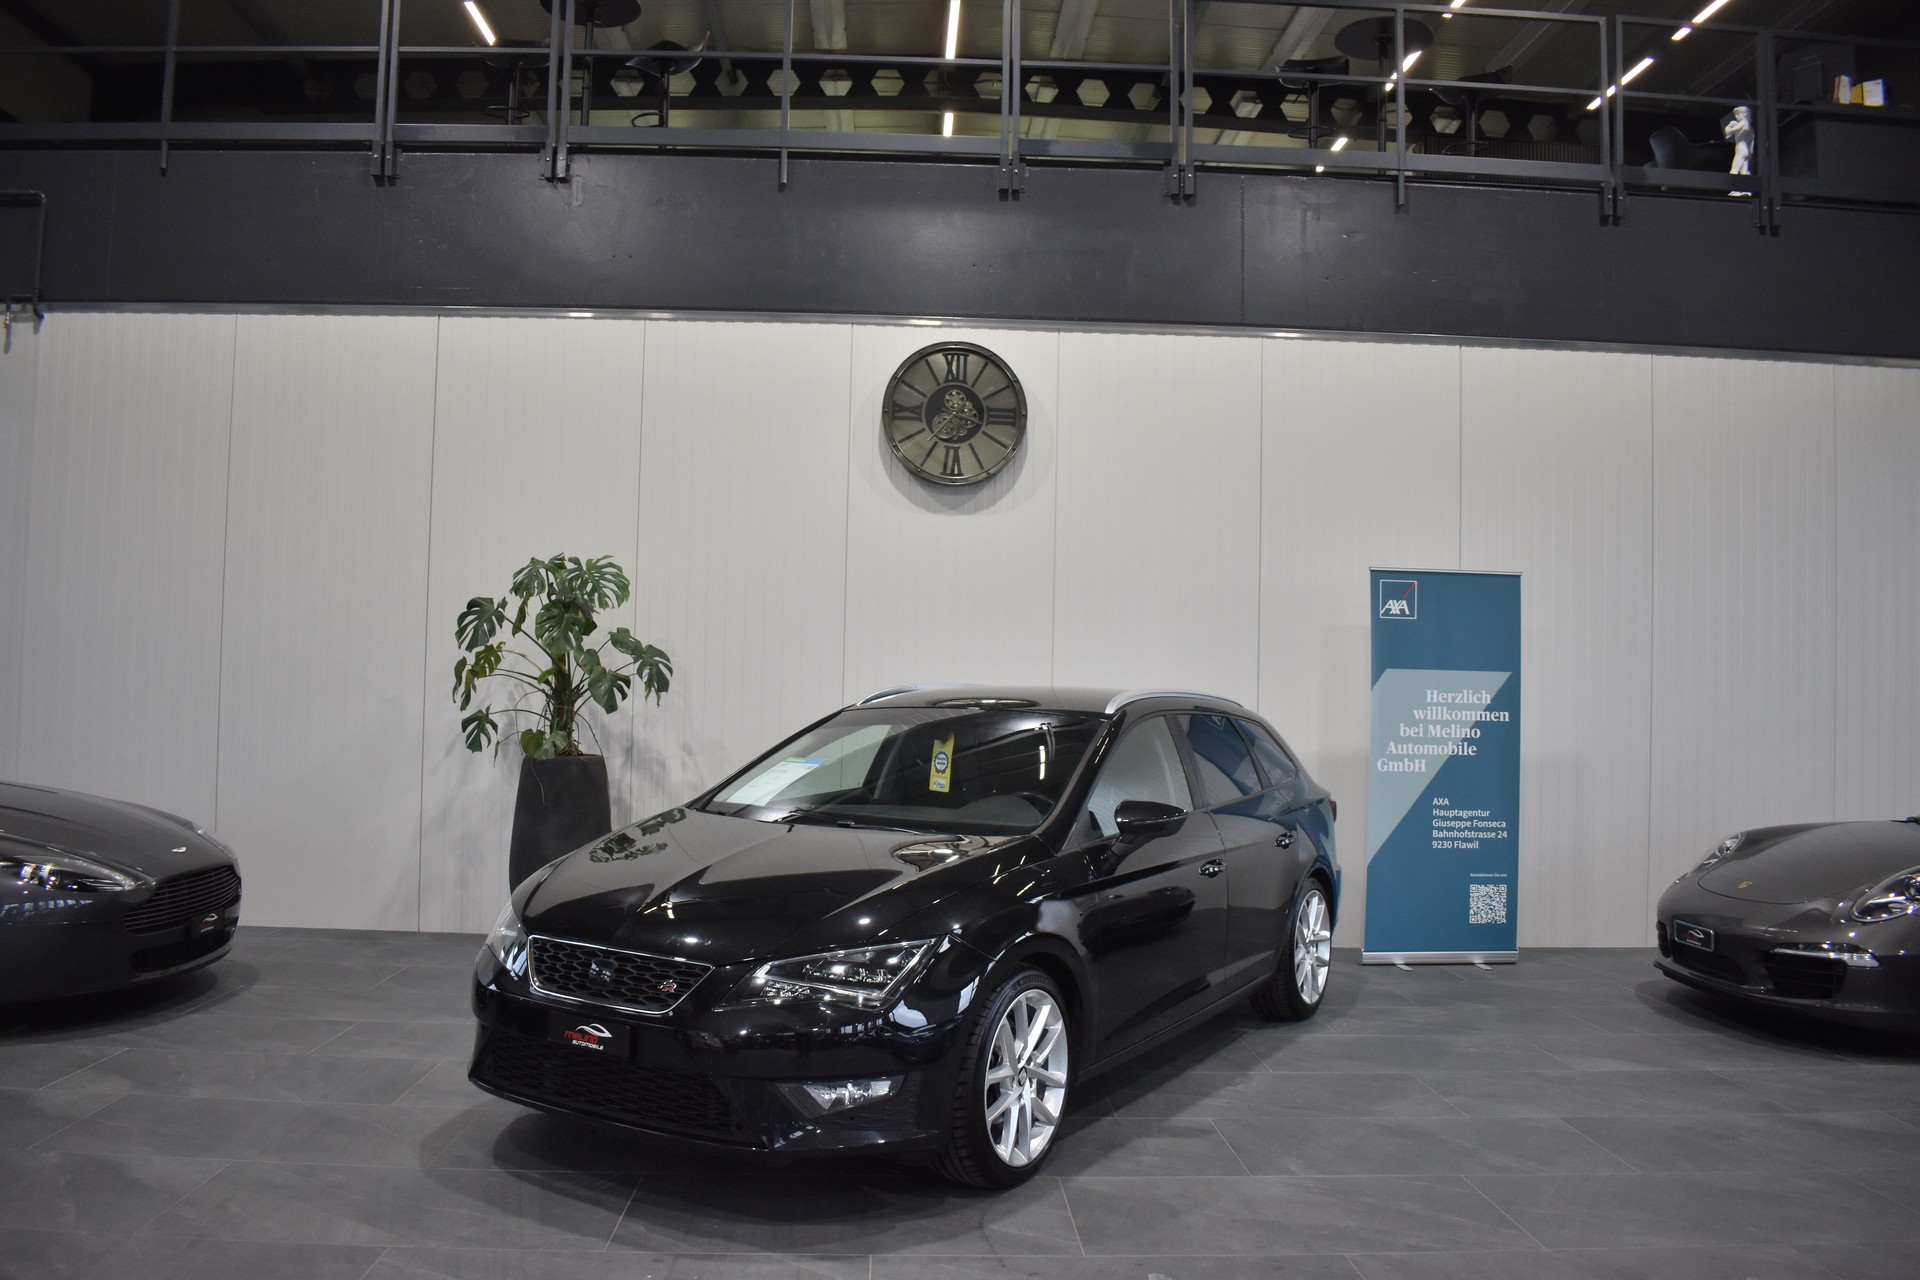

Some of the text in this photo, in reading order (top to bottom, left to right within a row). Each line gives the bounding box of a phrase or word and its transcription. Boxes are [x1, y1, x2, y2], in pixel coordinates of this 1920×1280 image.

[942, 352, 969, 384] XII
[986, 405, 1017, 427] III
[1381, 599, 1410, 615] AXA
[1426, 689, 1491, 704] Herzlich
[1413, 707, 1510, 722] willkommen
[1400, 723, 1481, 739] bei Melino
[1386, 741, 1477, 756] Automobile
[1377, 758, 1426, 773] GmbH
[1432, 797, 1450, 806] AXA
[1432, 808, 1491, 818] Hauptagentur
[1432, 819, 1507, 829] Giuseppe Fonseca
[1432, 830, 1508, 839] Bahnhofstrasse 24
[1432, 840, 1479, 849] 9230 Flawil
